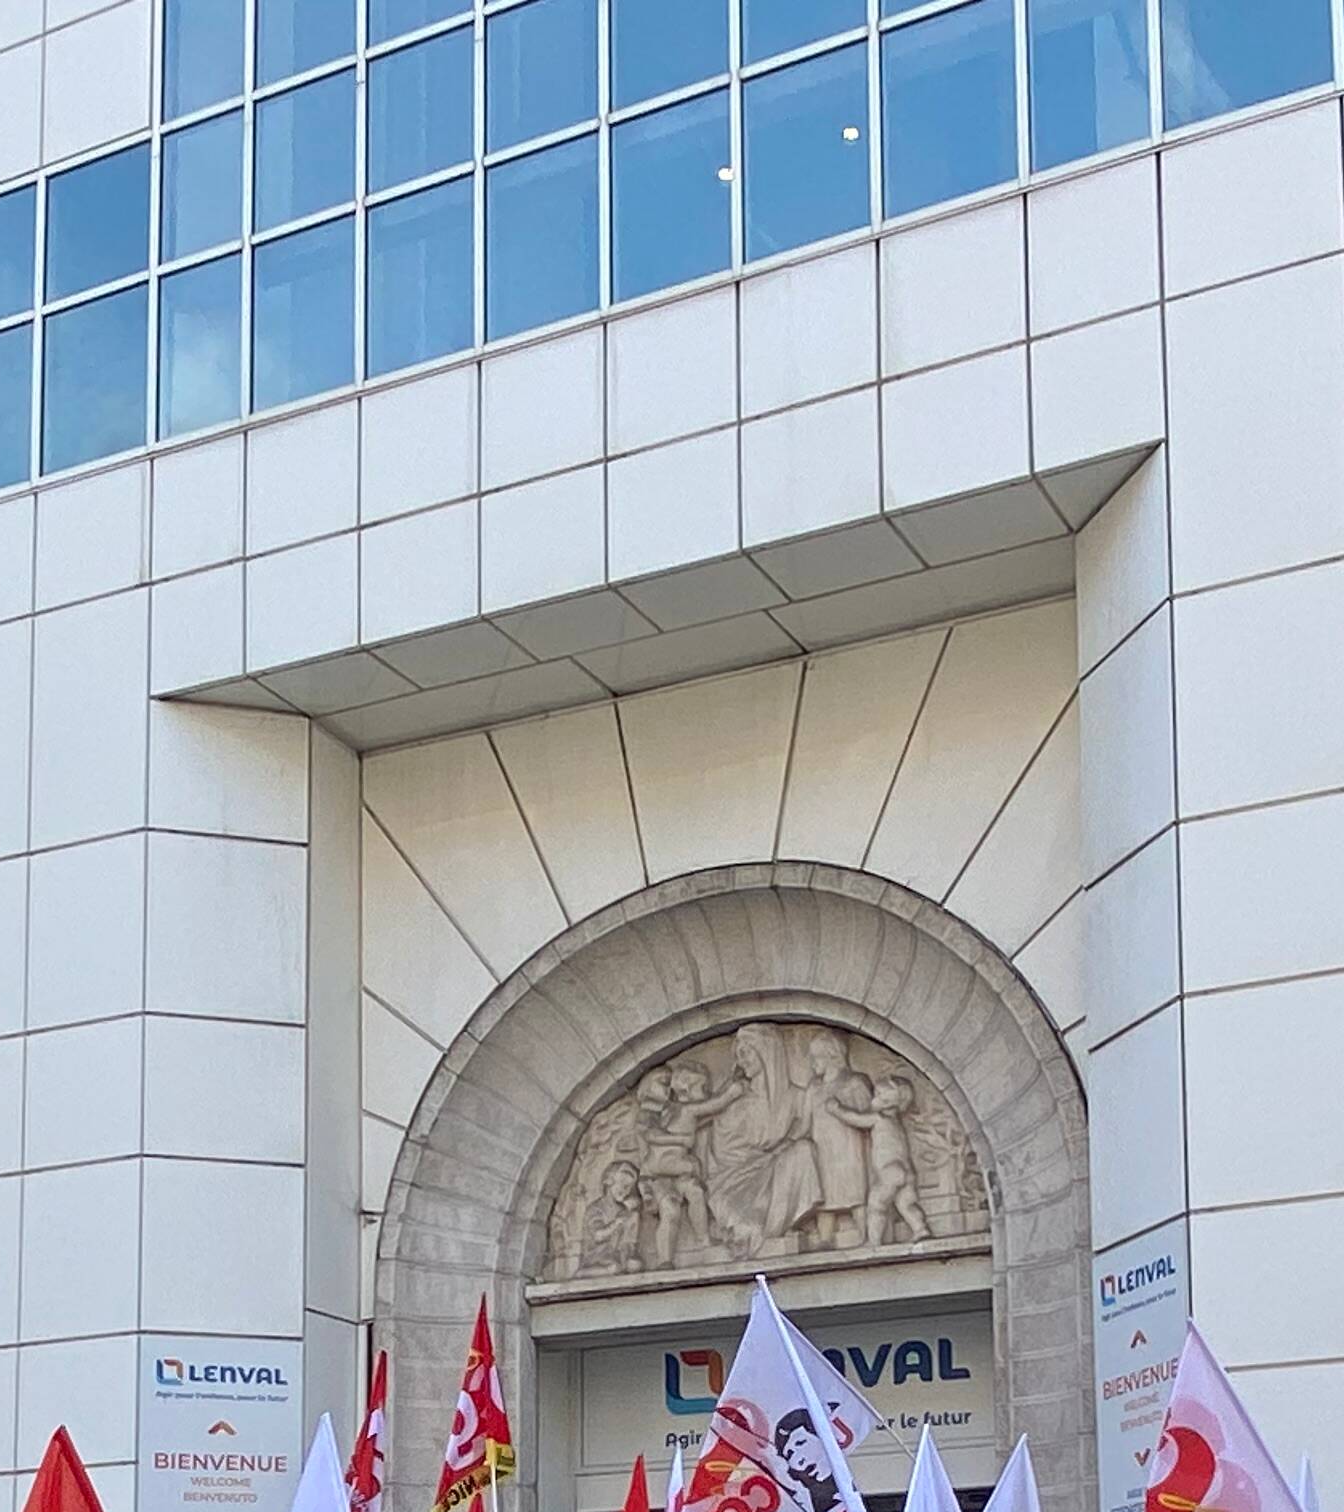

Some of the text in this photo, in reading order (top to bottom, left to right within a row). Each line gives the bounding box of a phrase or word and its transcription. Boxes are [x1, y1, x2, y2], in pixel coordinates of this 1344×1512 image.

[1118, 1255, 1176, 1294] LENVAL
[189, 1365, 288, 1386] LENVAL
[1103, 1358, 1179, 1400] BIENVENUE
[665, 1431, 703, 1450] Agir
[900, 1411, 919, 1429] le
[154, 1452, 288, 1473] BIENVENUE
